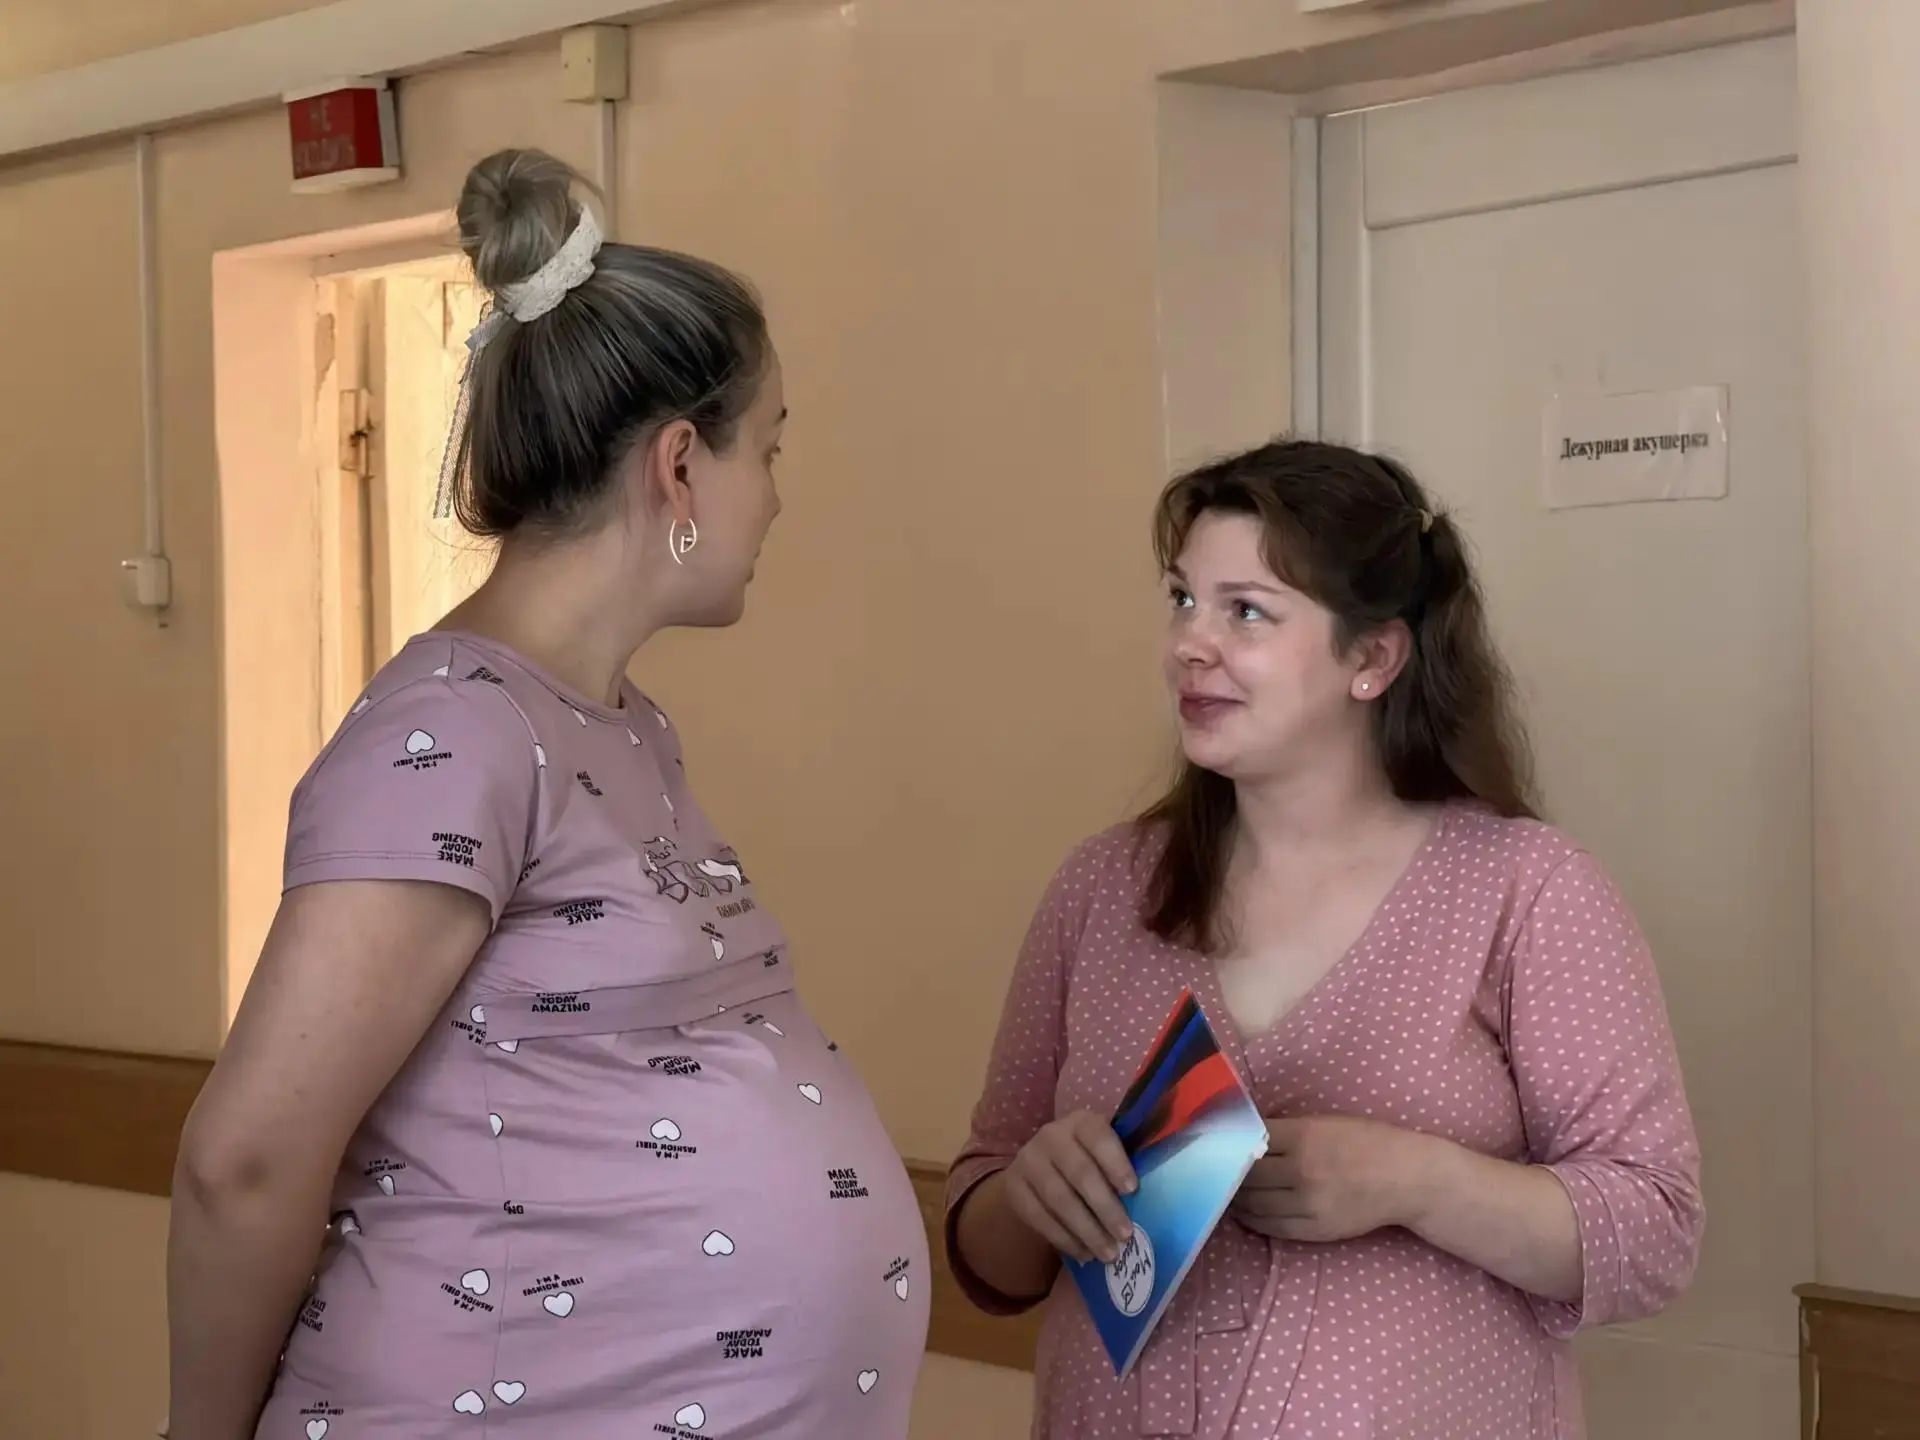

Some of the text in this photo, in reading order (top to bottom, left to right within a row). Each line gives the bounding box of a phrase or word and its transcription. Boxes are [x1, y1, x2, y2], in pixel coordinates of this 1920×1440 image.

[1560, 432, 1709, 461] Дежурная акушерка
[432, 832, 482, 849] AMAZING
[441, 842, 473, 856] TODAY
[438, 850, 475, 867] MAKE
[552, 899, 603, 918] AMAZING
[566, 911, 605, 926] MAKE
[531, 1001, 591, 1013] AMAZING
[540, 995, 578, 1005] TODAY
[666, 1060, 702, 1076] MAKE
[827, 1167, 858, 1181] MAKE
[833, 1180, 858, 1190] TODAY
[829, 1187, 869, 1200] AMAZING
[716, 1328, 773, 1342] AMAZING
[726, 1337, 761, 1348] TODAY
[723, 1346, 763, 1359] MAKE
